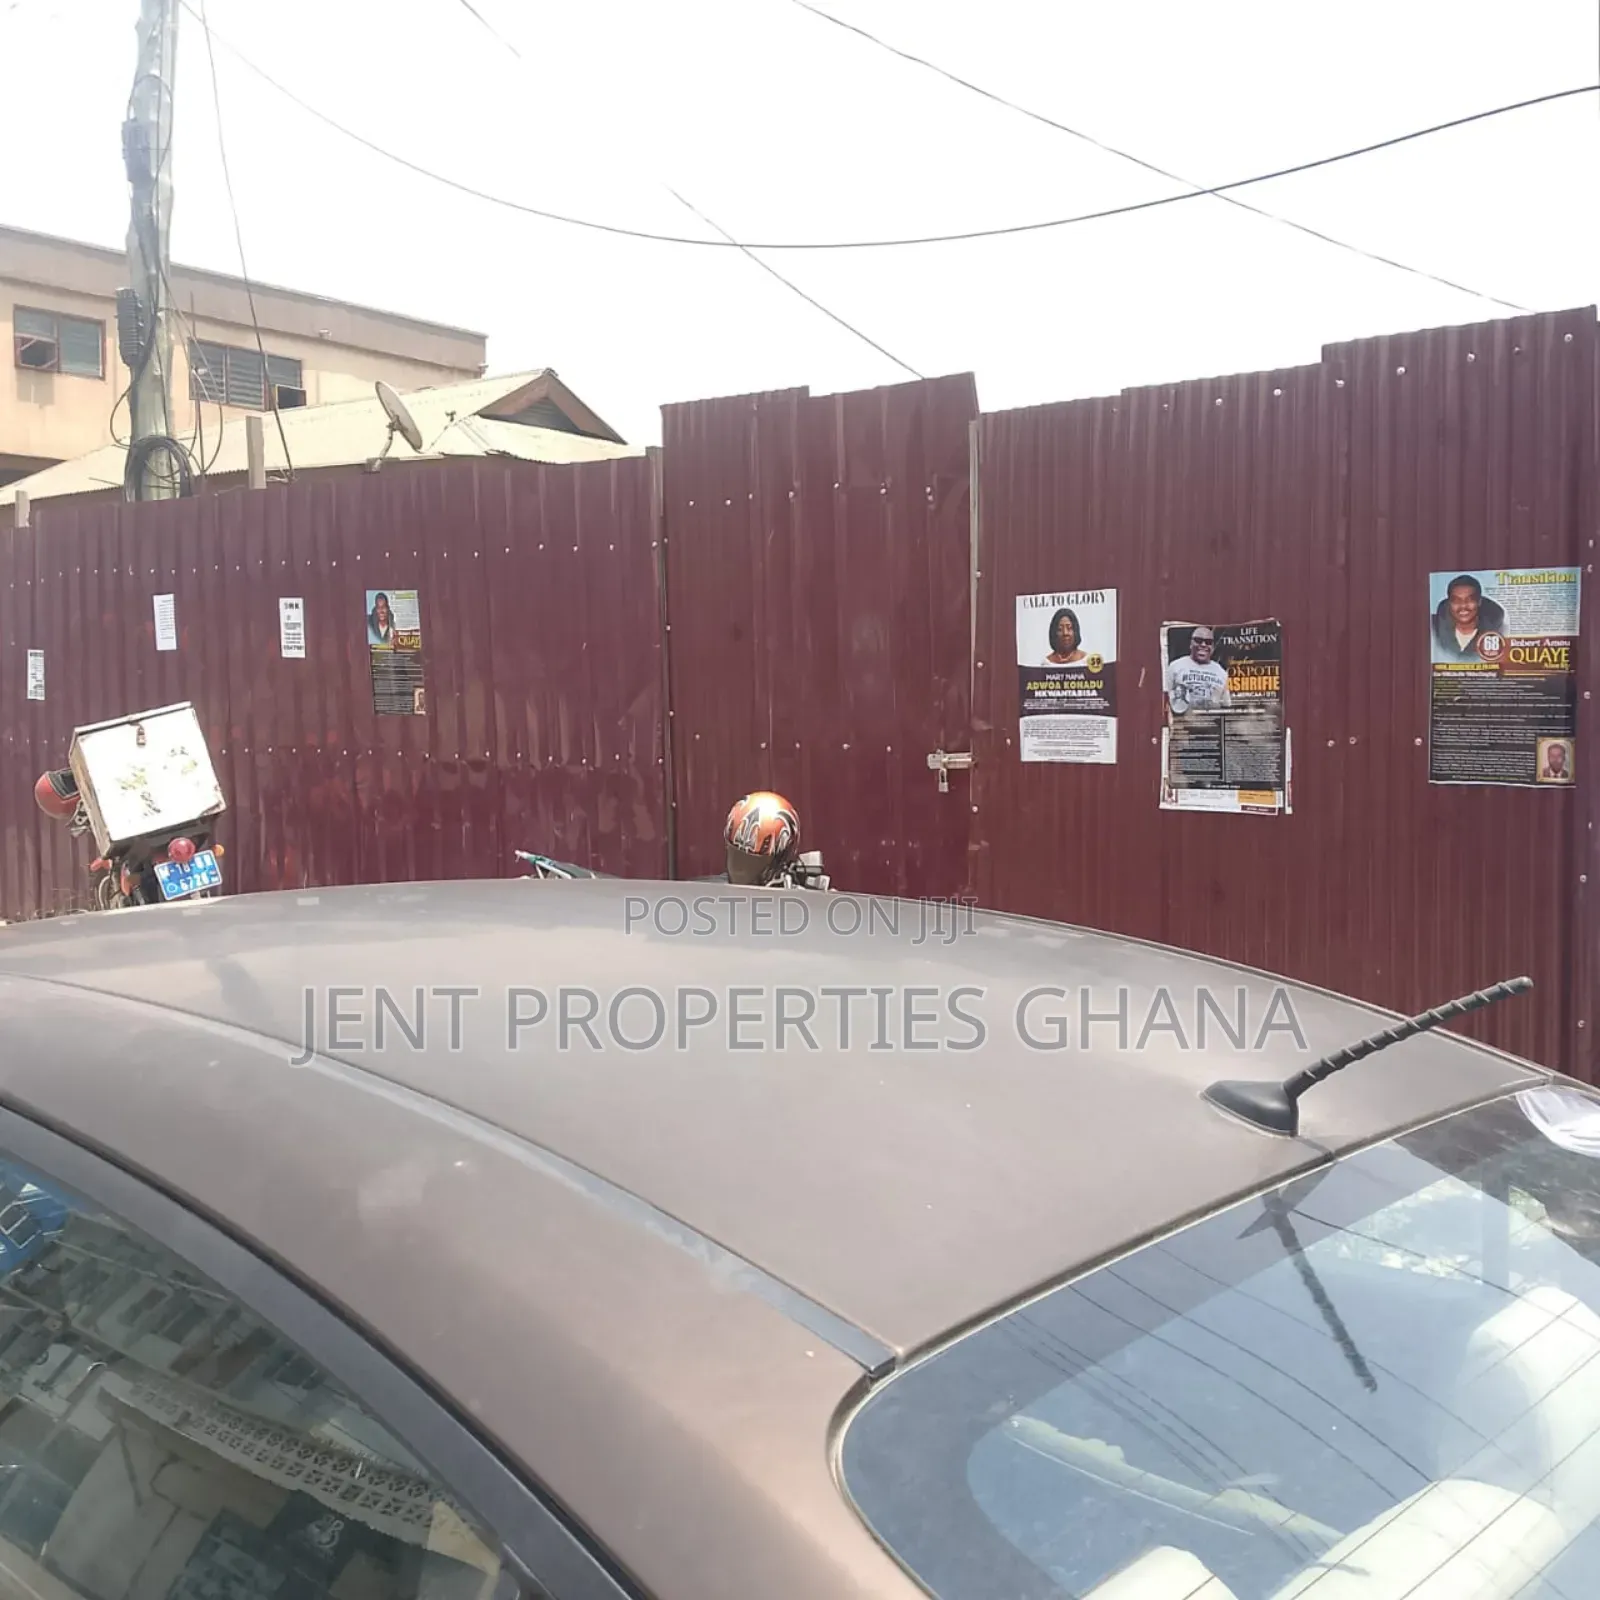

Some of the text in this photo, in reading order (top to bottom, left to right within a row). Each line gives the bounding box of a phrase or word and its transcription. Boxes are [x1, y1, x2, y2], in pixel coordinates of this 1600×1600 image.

[1495, 571, 1576, 586] Transition
[1050, 594, 1065, 607] TO
[1066, 591, 1106, 606] GLORY
[1222, 633, 1278, 645] TRANSITION
[1240, 627, 1258, 636] LIFE
[1483, 635, 1500, 651] 68
[1509, 646, 1570, 664] QUAYE
[1026, 681, 1061, 690] ADWOA
